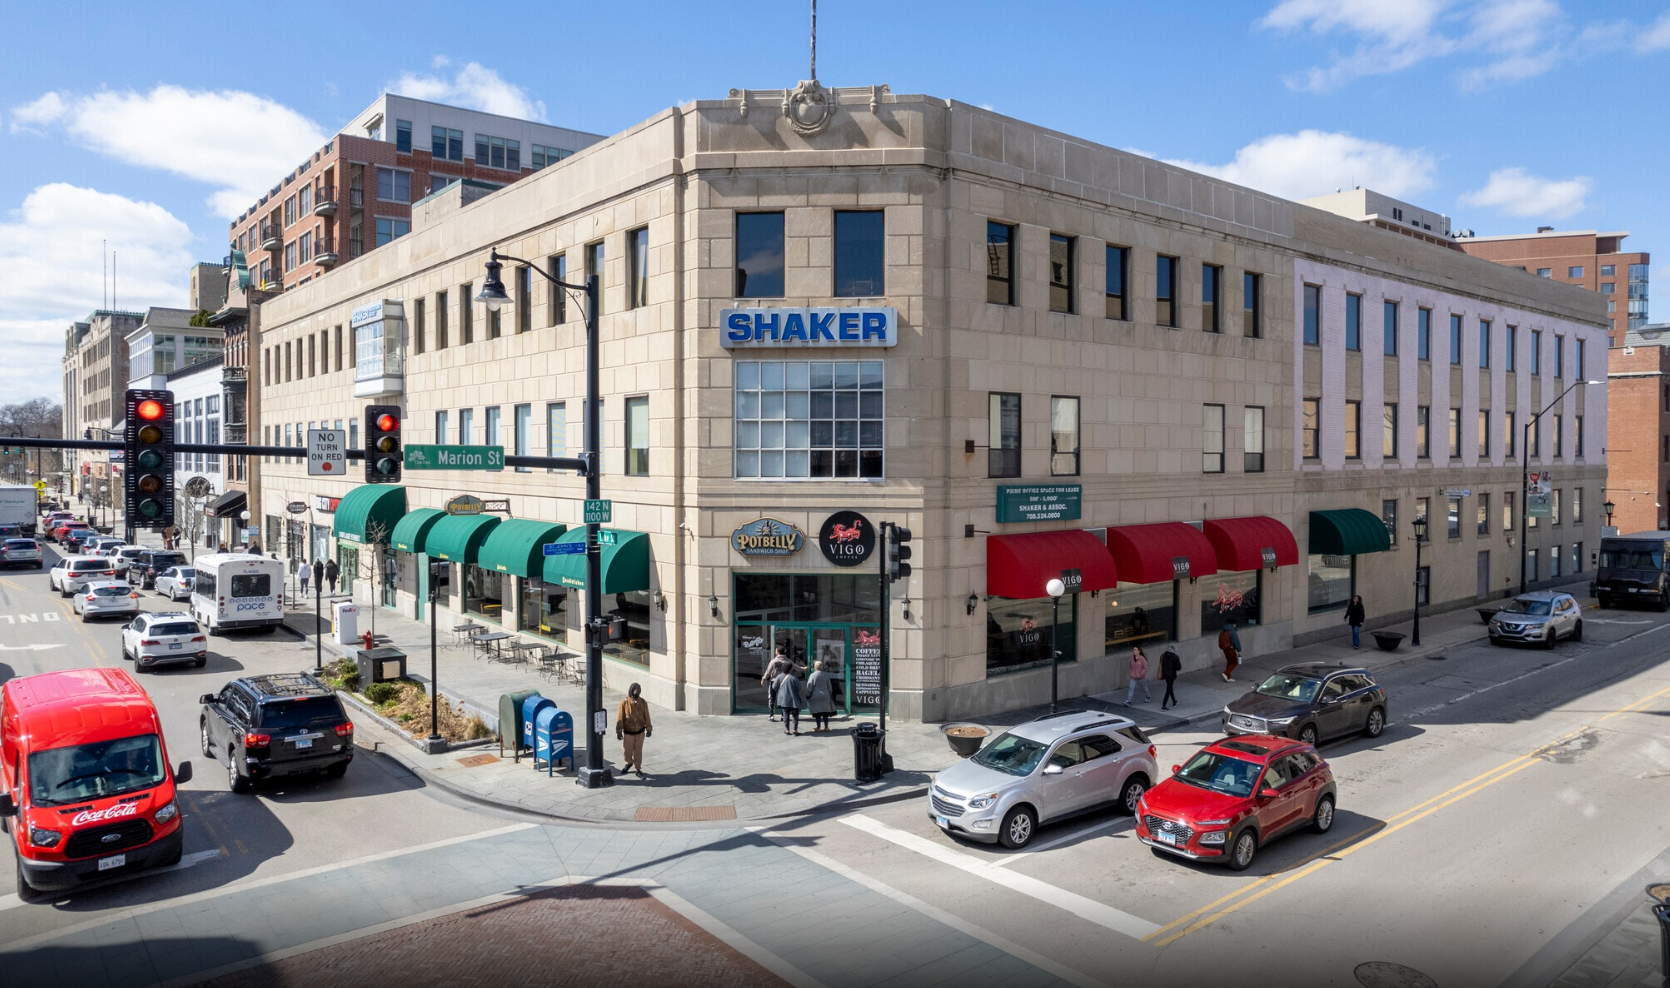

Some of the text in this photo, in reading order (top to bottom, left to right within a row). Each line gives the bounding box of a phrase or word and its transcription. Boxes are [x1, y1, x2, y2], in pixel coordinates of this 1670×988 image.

[728, 313, 888, 341] SHAKER
[318, 433, 334, 441] NO
[438, 450, 500, 465] Marion St
[586, 501, 609, 511] 142 N
[1019, 504, 1041, 512] SHAKER
[586, 511, 610, 522] 1100 W
[736, 532, 798, 550] POTBELLY
[829, 544, 865, 555] VIGO
[1173, 562, 1190, 571] VIGO
[1061, 575, 1082, 585] VIGO
[237, 602, 265, 612] pace
[1019, 632, 1040, 643] VIGO
[72, 801, 139, 826] Coca-Cola
